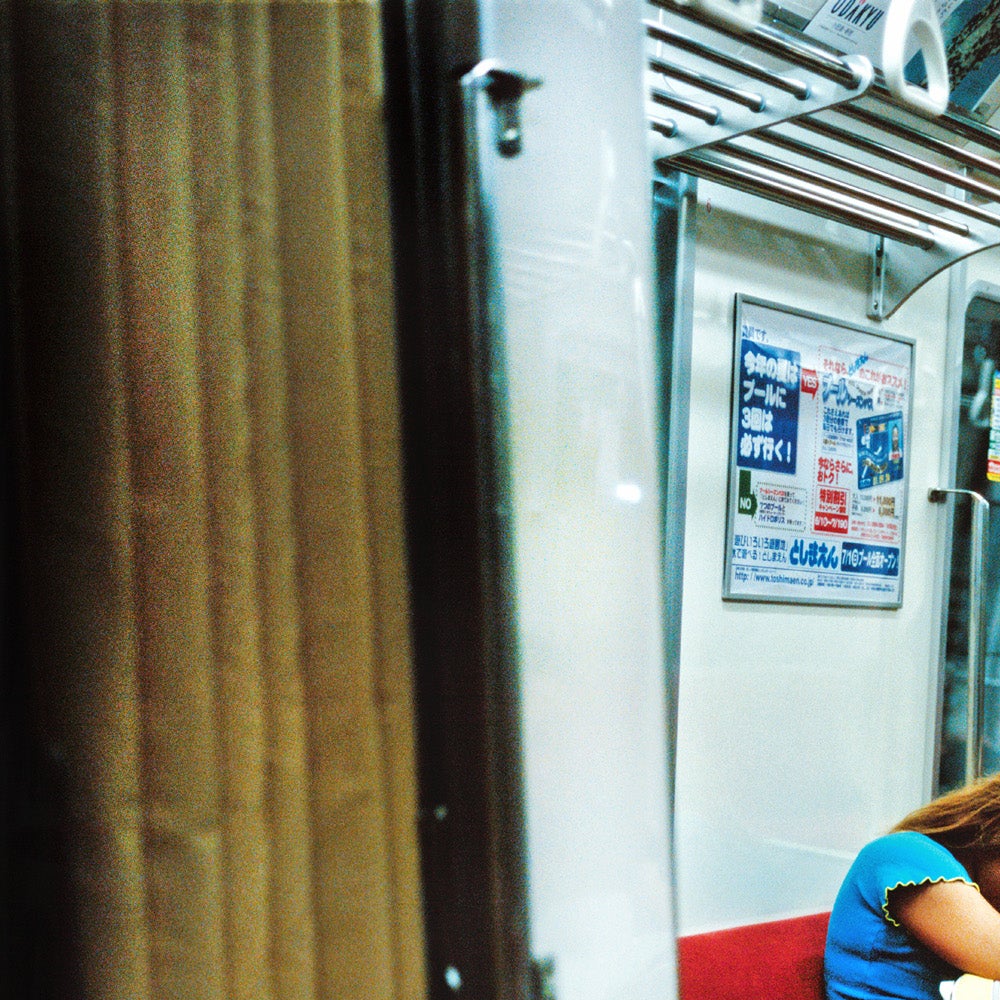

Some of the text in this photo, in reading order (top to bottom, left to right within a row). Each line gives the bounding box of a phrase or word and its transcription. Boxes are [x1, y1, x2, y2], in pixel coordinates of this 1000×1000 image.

[743, 379, 787, 408] プールに
[802, 374, 817, 388] YES
[742, 407, 773, 433] 3回は
[740, 433, 791, 463] 必ず行く！
[740, 498, 752, 511] NO
[819, 488, 847, 506] 特別割引
[789, 539, 838, 569] としまえん
